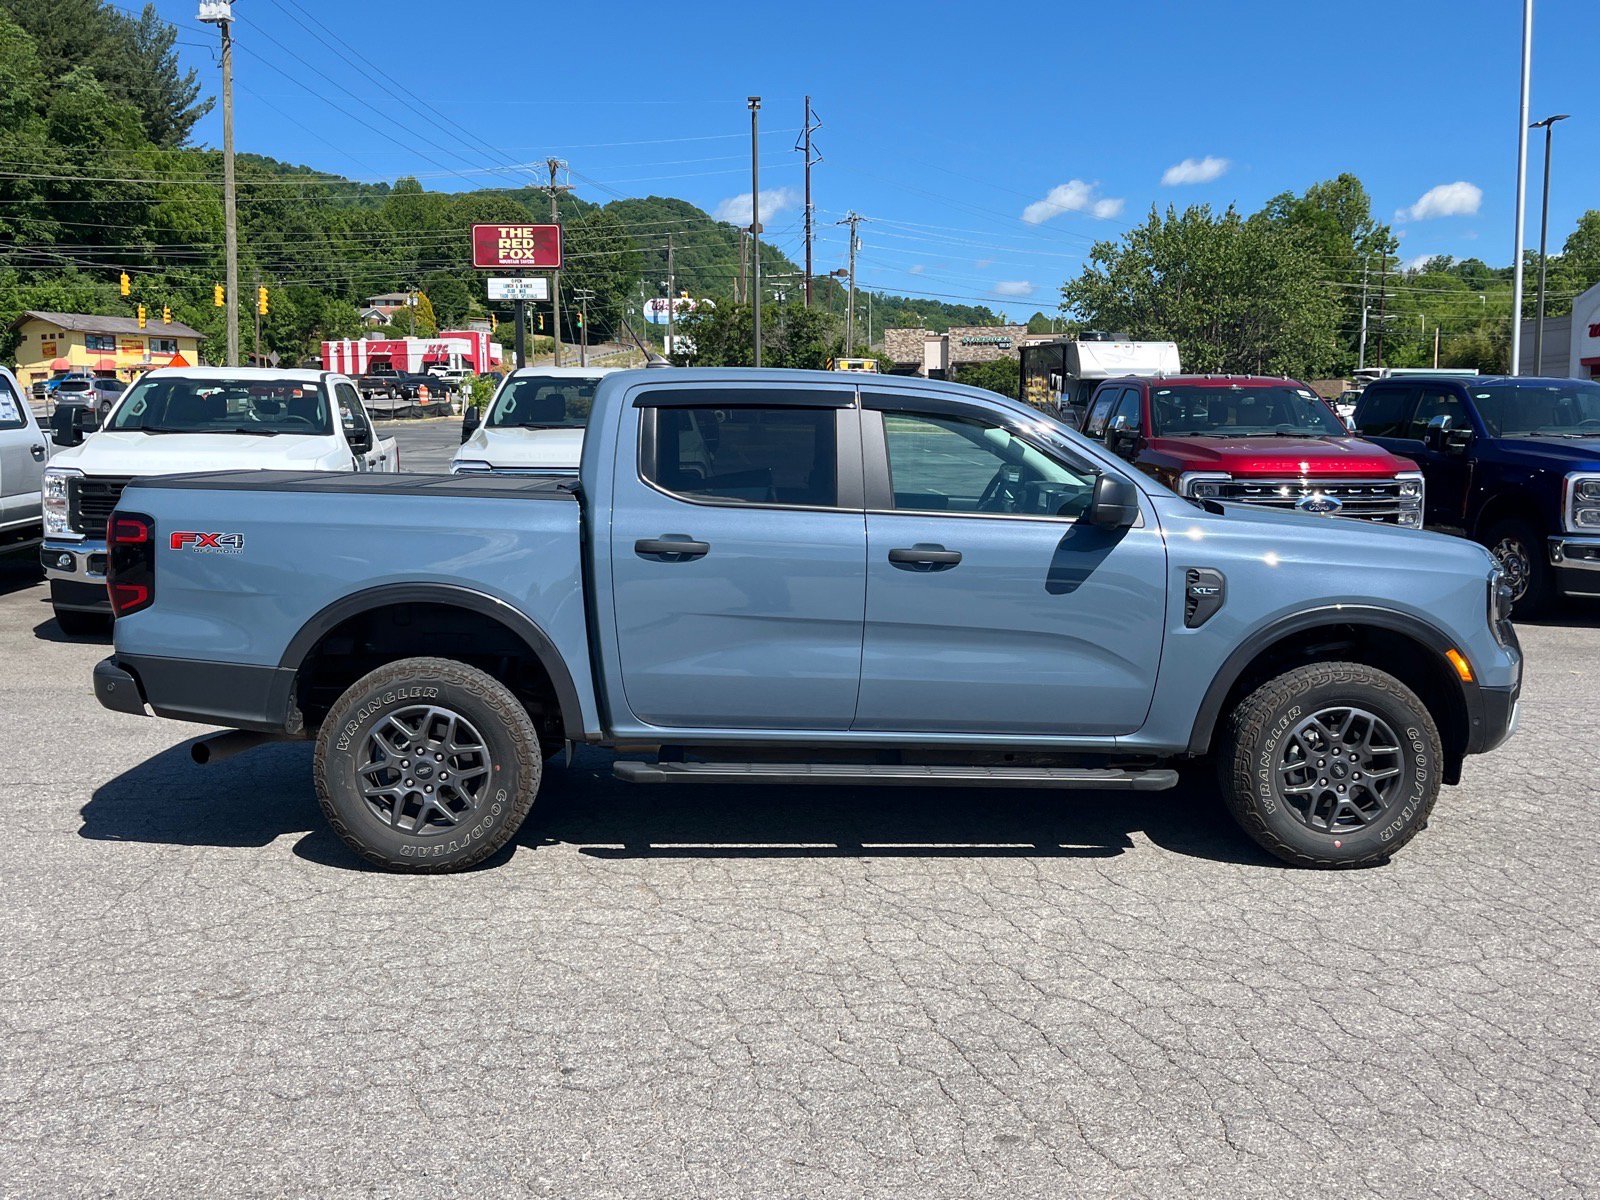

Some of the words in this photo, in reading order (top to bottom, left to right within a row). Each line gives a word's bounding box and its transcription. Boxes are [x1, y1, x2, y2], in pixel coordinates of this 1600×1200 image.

[498, 227, 534, 238] THE
[498, 238, 535, 249] RED
[498, 248, 535, 259] FOX
[169, 531, 245, 550] FX4
[1192, 587, 1220, 595] XLT
[336, 686, 440, 752] WRANGLER
[1258, 705, 1302, 815] WRANGLER
[1379, 727, 1428, 842] GOODYEAR
[399, 788, 508, 858] GOODYEAR
